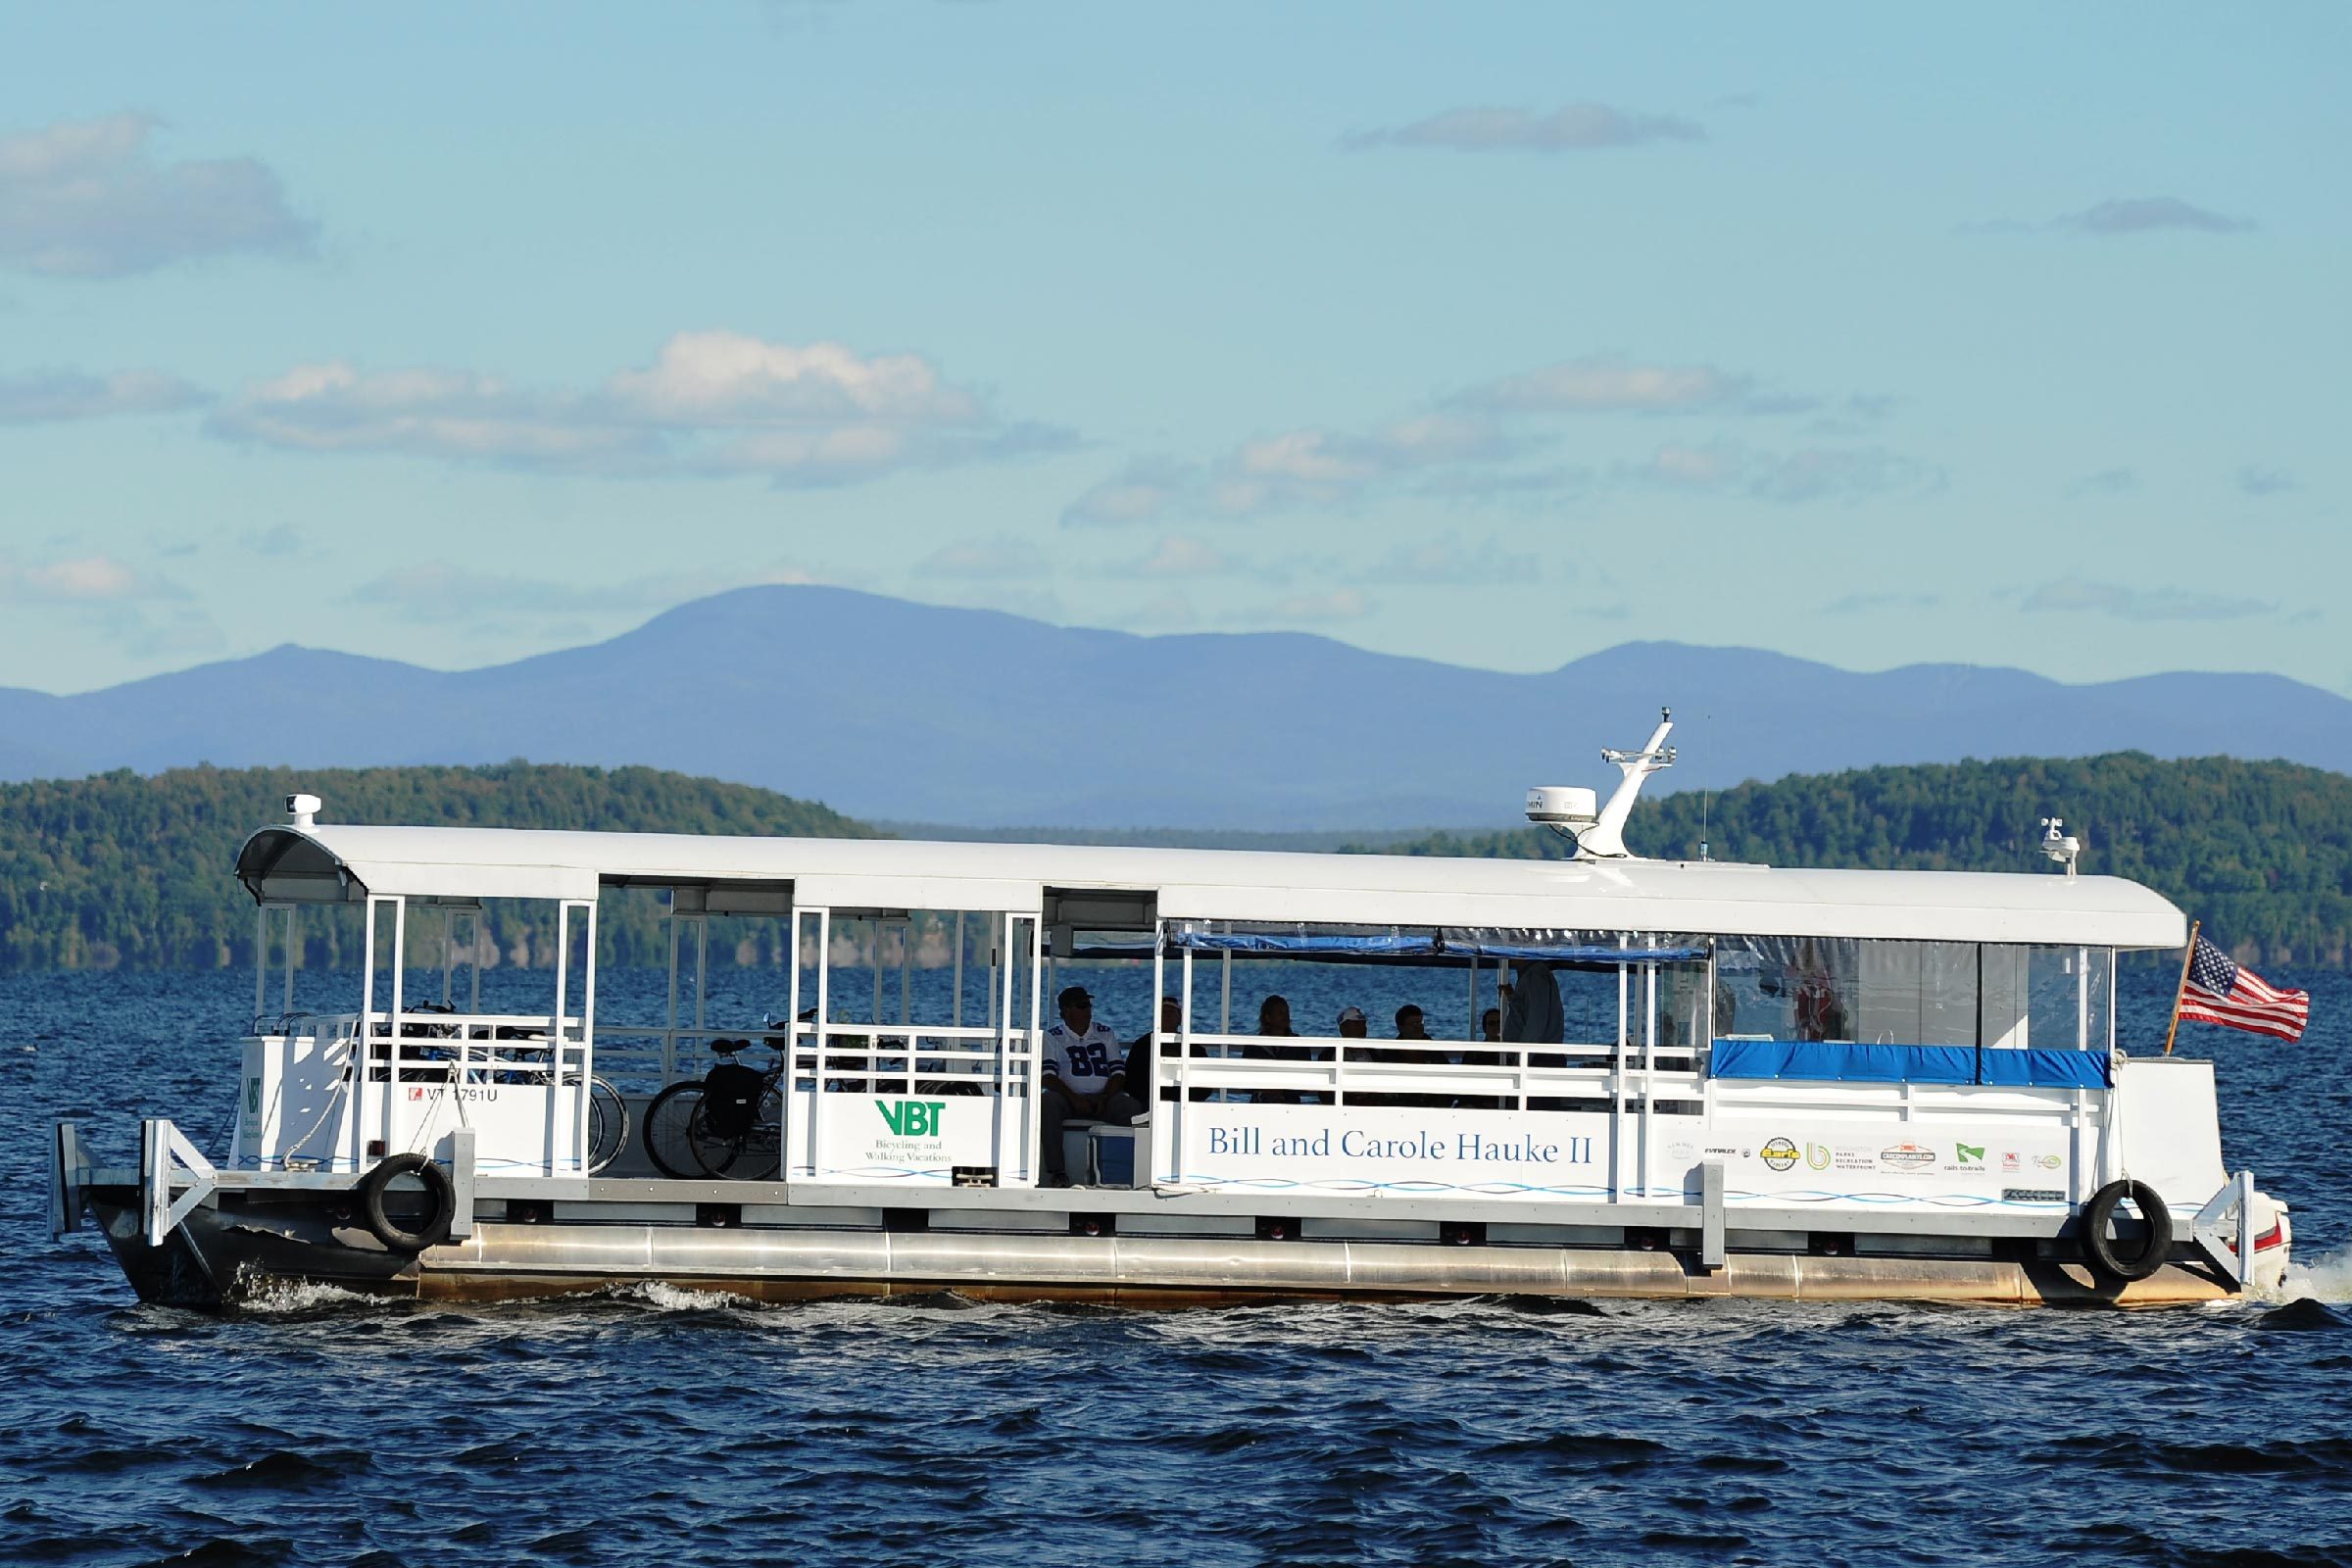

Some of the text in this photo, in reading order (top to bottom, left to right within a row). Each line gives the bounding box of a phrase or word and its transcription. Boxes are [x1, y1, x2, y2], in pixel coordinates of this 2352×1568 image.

[1065, 1043, 1109, 1077] 82
[426, 1088, 498, 1102] VT 1791U
[874, 1100, 947, 1137] VBT
[864, 1152, 953, 1163] Walking Vacations
[875, 1140, 942, 1152] Bicycling and
[1210, 1127, 1593, 1164] Bill and Carole Hauke II
